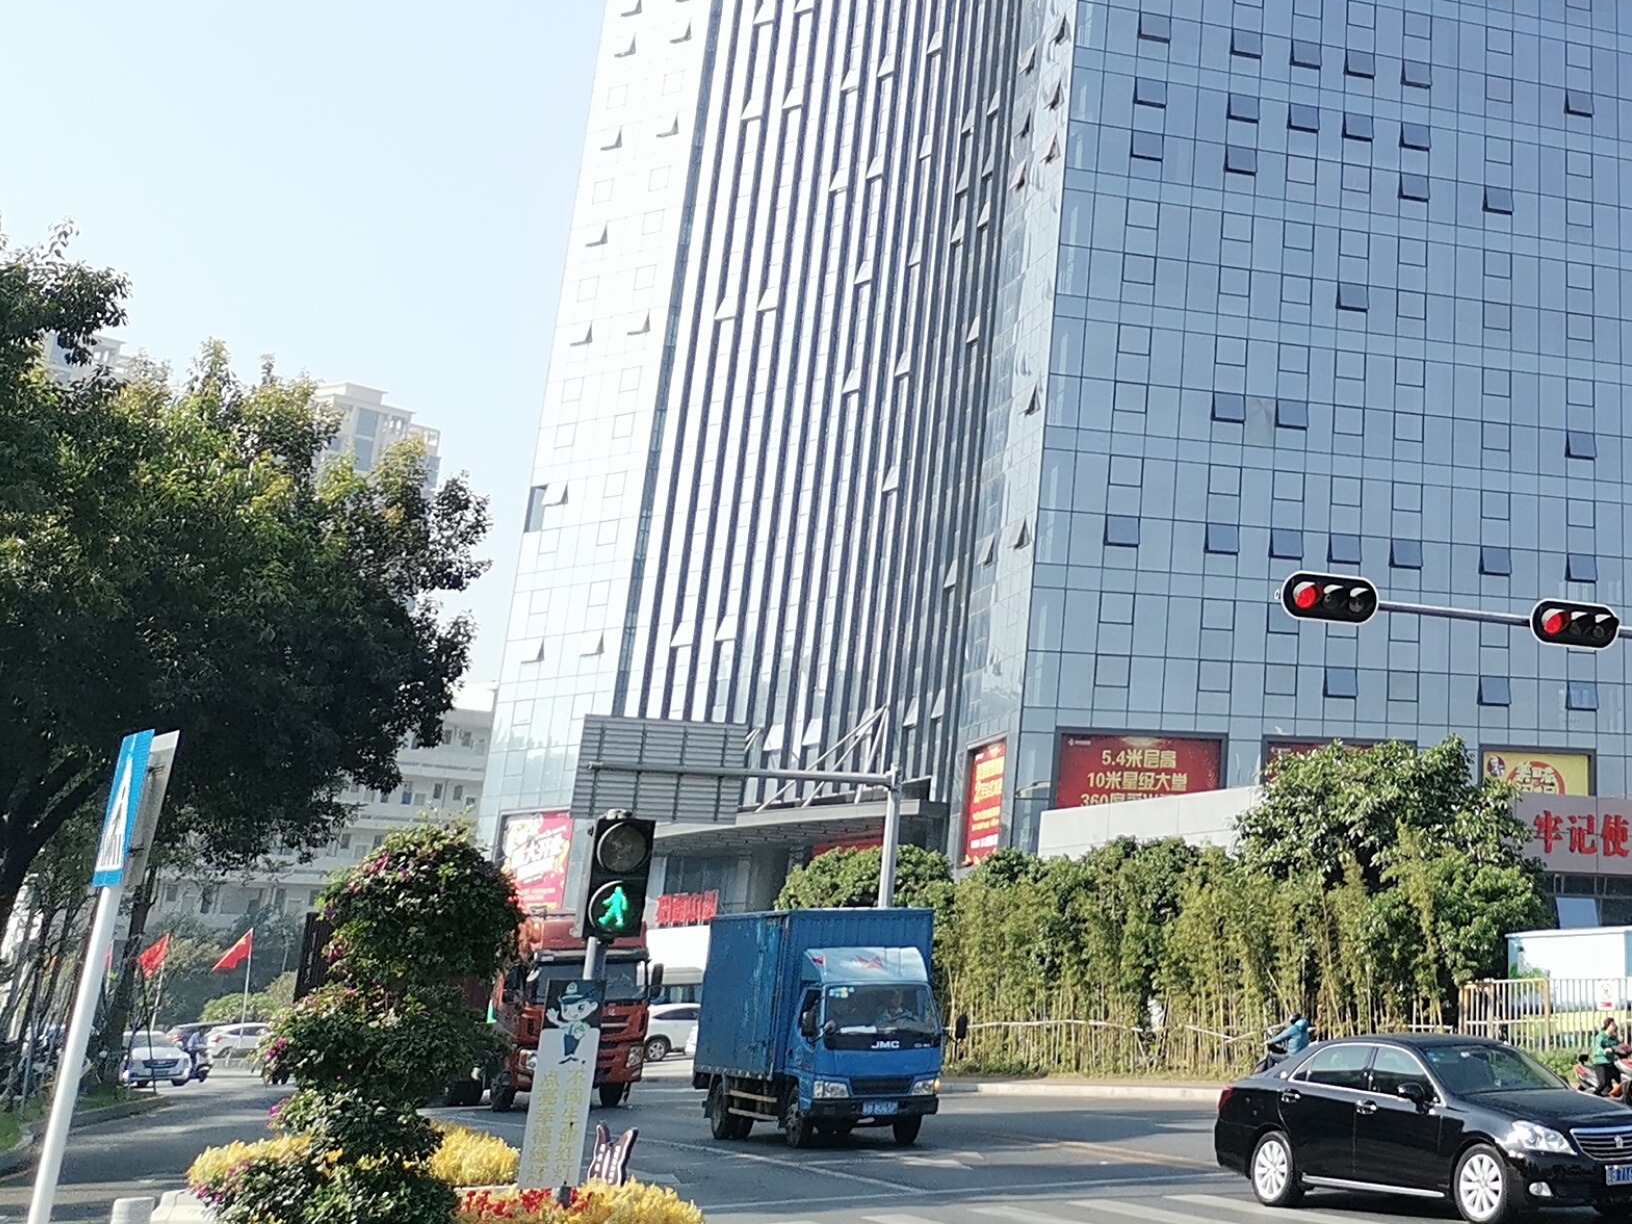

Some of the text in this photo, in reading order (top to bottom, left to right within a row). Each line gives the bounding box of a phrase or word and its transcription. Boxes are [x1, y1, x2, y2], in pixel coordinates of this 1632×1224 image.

[1102, 748, 1178, 769] 5.4米层高
[1087, 770, 1188, 791] 10米星级大堂
[870, 1040, 900, 1049] JMC
